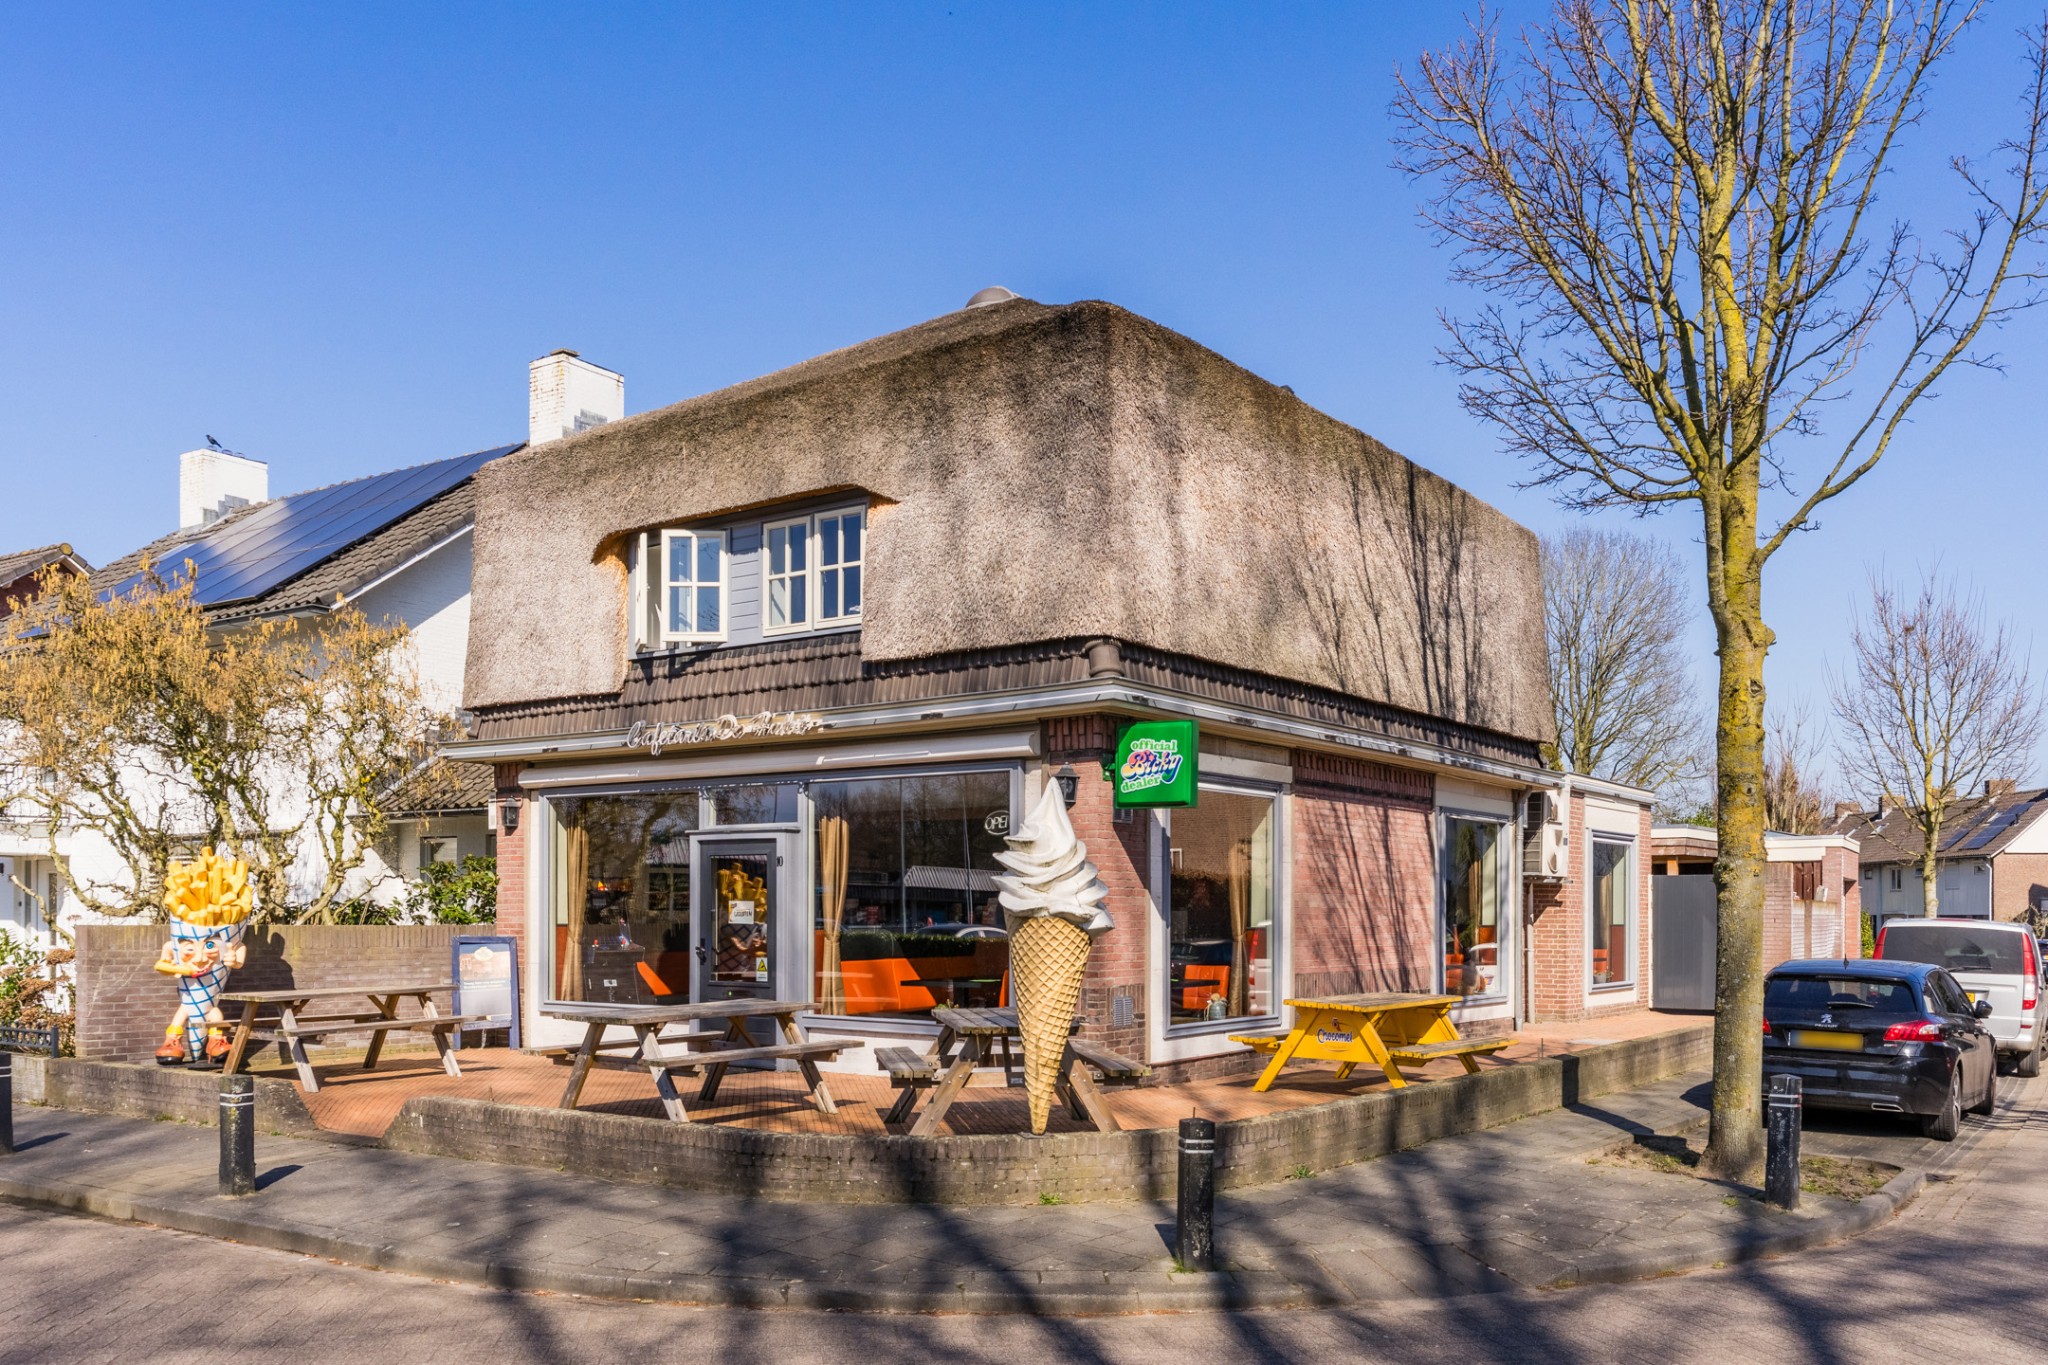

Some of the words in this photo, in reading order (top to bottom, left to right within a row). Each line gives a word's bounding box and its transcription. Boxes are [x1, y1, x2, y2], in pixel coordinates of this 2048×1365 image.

[1131, 739, 1177, 751] official
[1121, 750, 1183, 784] Bicky
[1121, 775, 1160, 793] dealer
[1317, 1028, 1353, 1044] Chocomel
